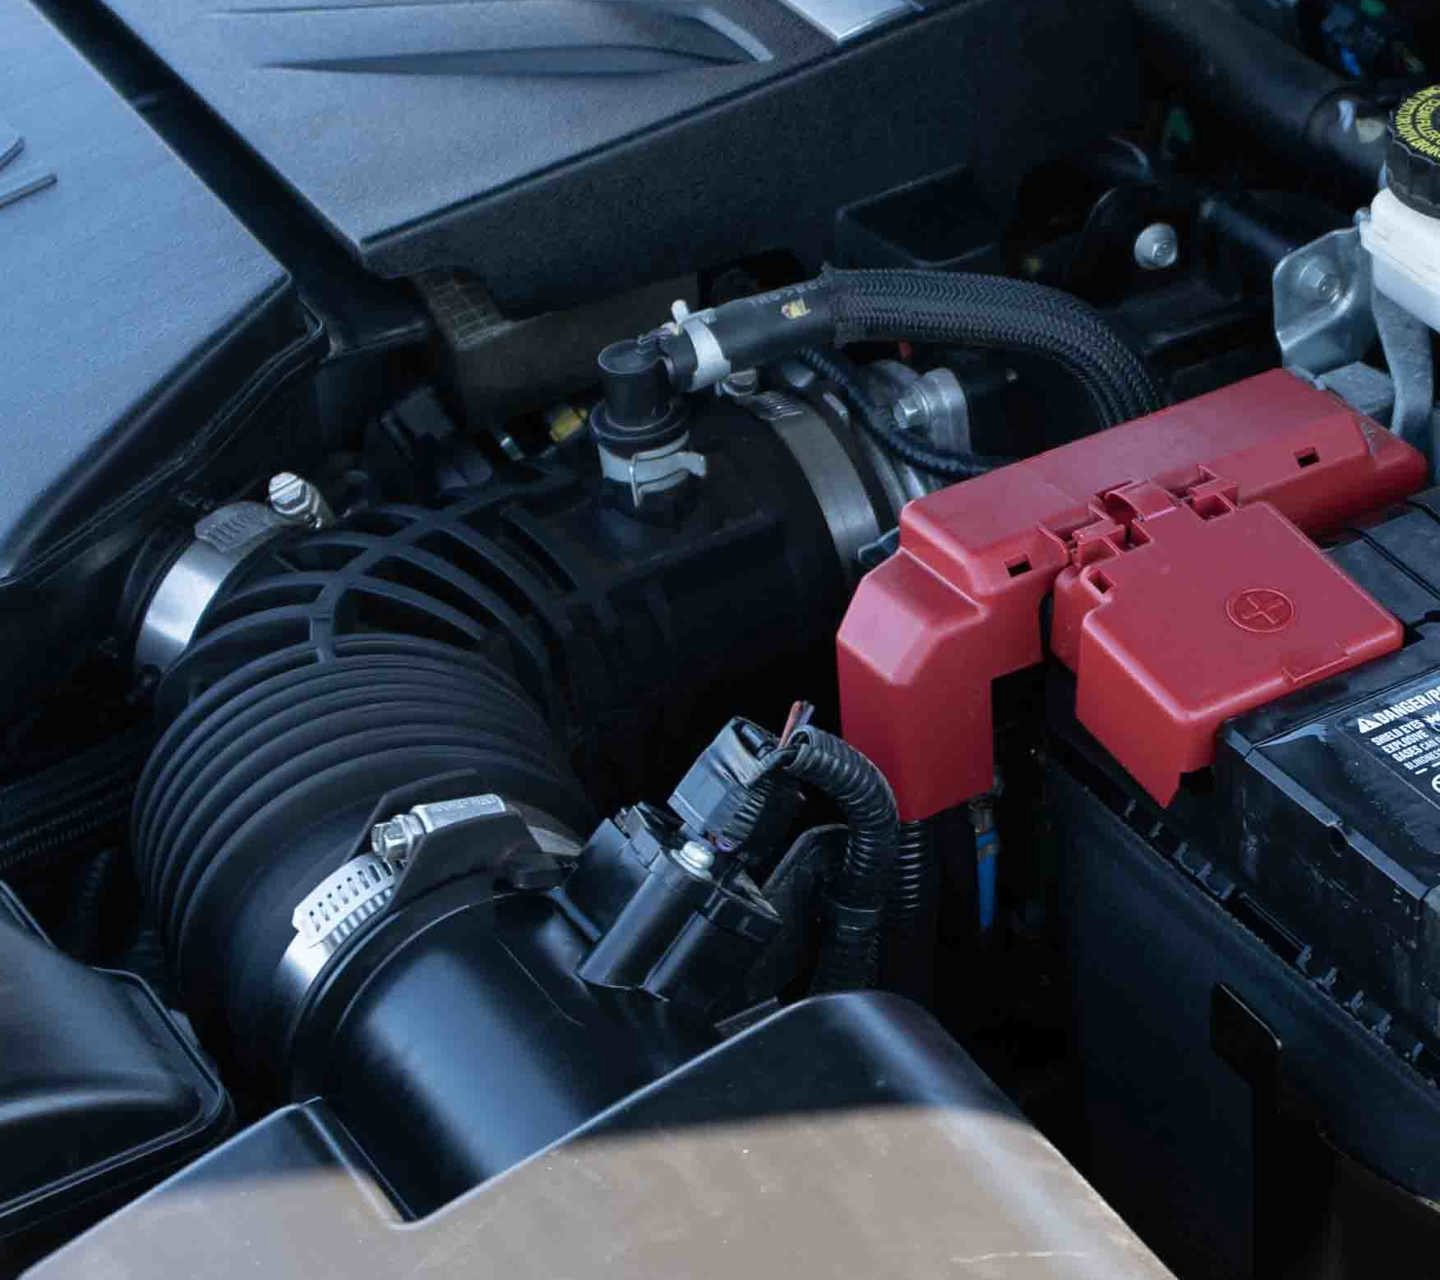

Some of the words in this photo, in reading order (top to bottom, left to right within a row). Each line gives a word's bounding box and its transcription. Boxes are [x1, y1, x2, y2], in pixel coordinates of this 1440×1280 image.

[1371, 728, 1405, 746] SHIELD
[1399, 719, 1426, 734] EYES
[1381, 728, 1430, 754] EXPLOSIVE
[1391, 744, 1423, 762] GASES
[1419, 738, 1439, 751] CAN
